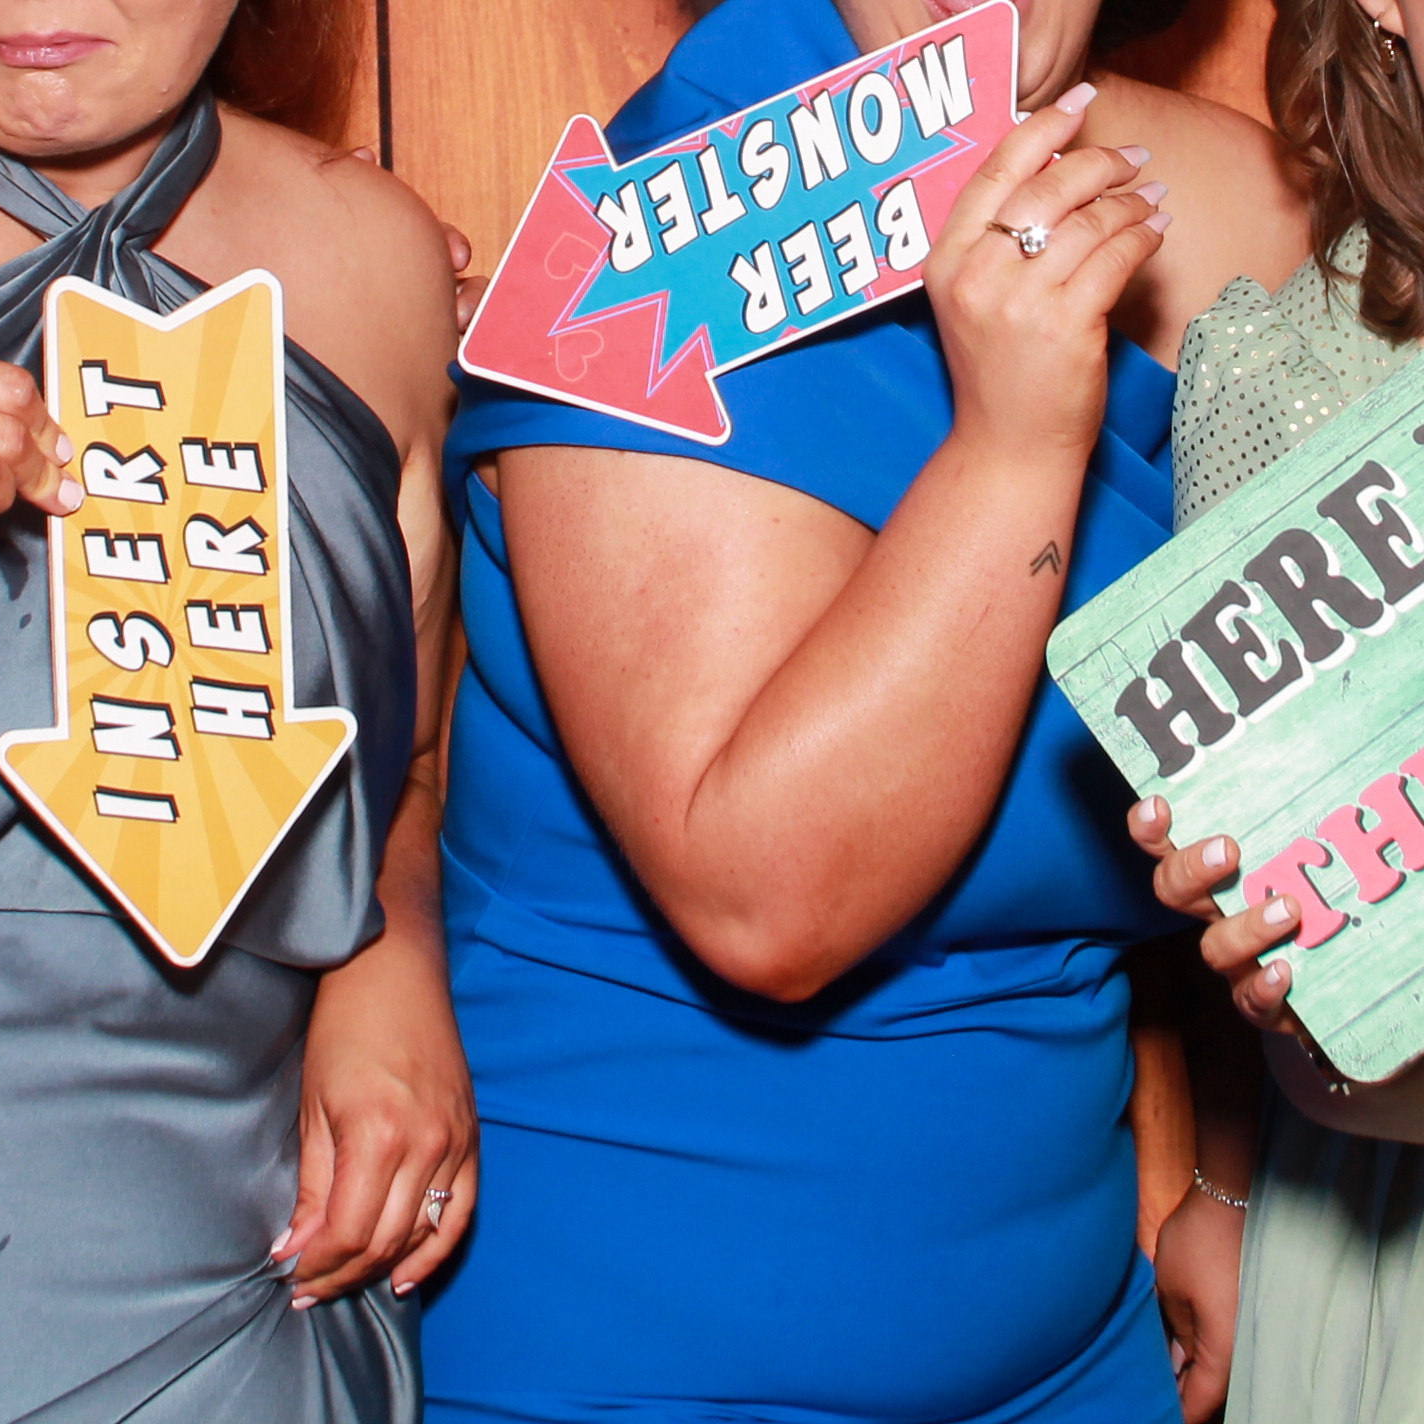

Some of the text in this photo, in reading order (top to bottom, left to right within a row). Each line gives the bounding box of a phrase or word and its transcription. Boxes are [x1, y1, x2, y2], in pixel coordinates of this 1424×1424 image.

[596, 35, 974, 273] MONSTER
[728, 178, 931, 334] BEER
[79, 360, 181, 823] INSERT
[180, 437, 273, 740] HERE
